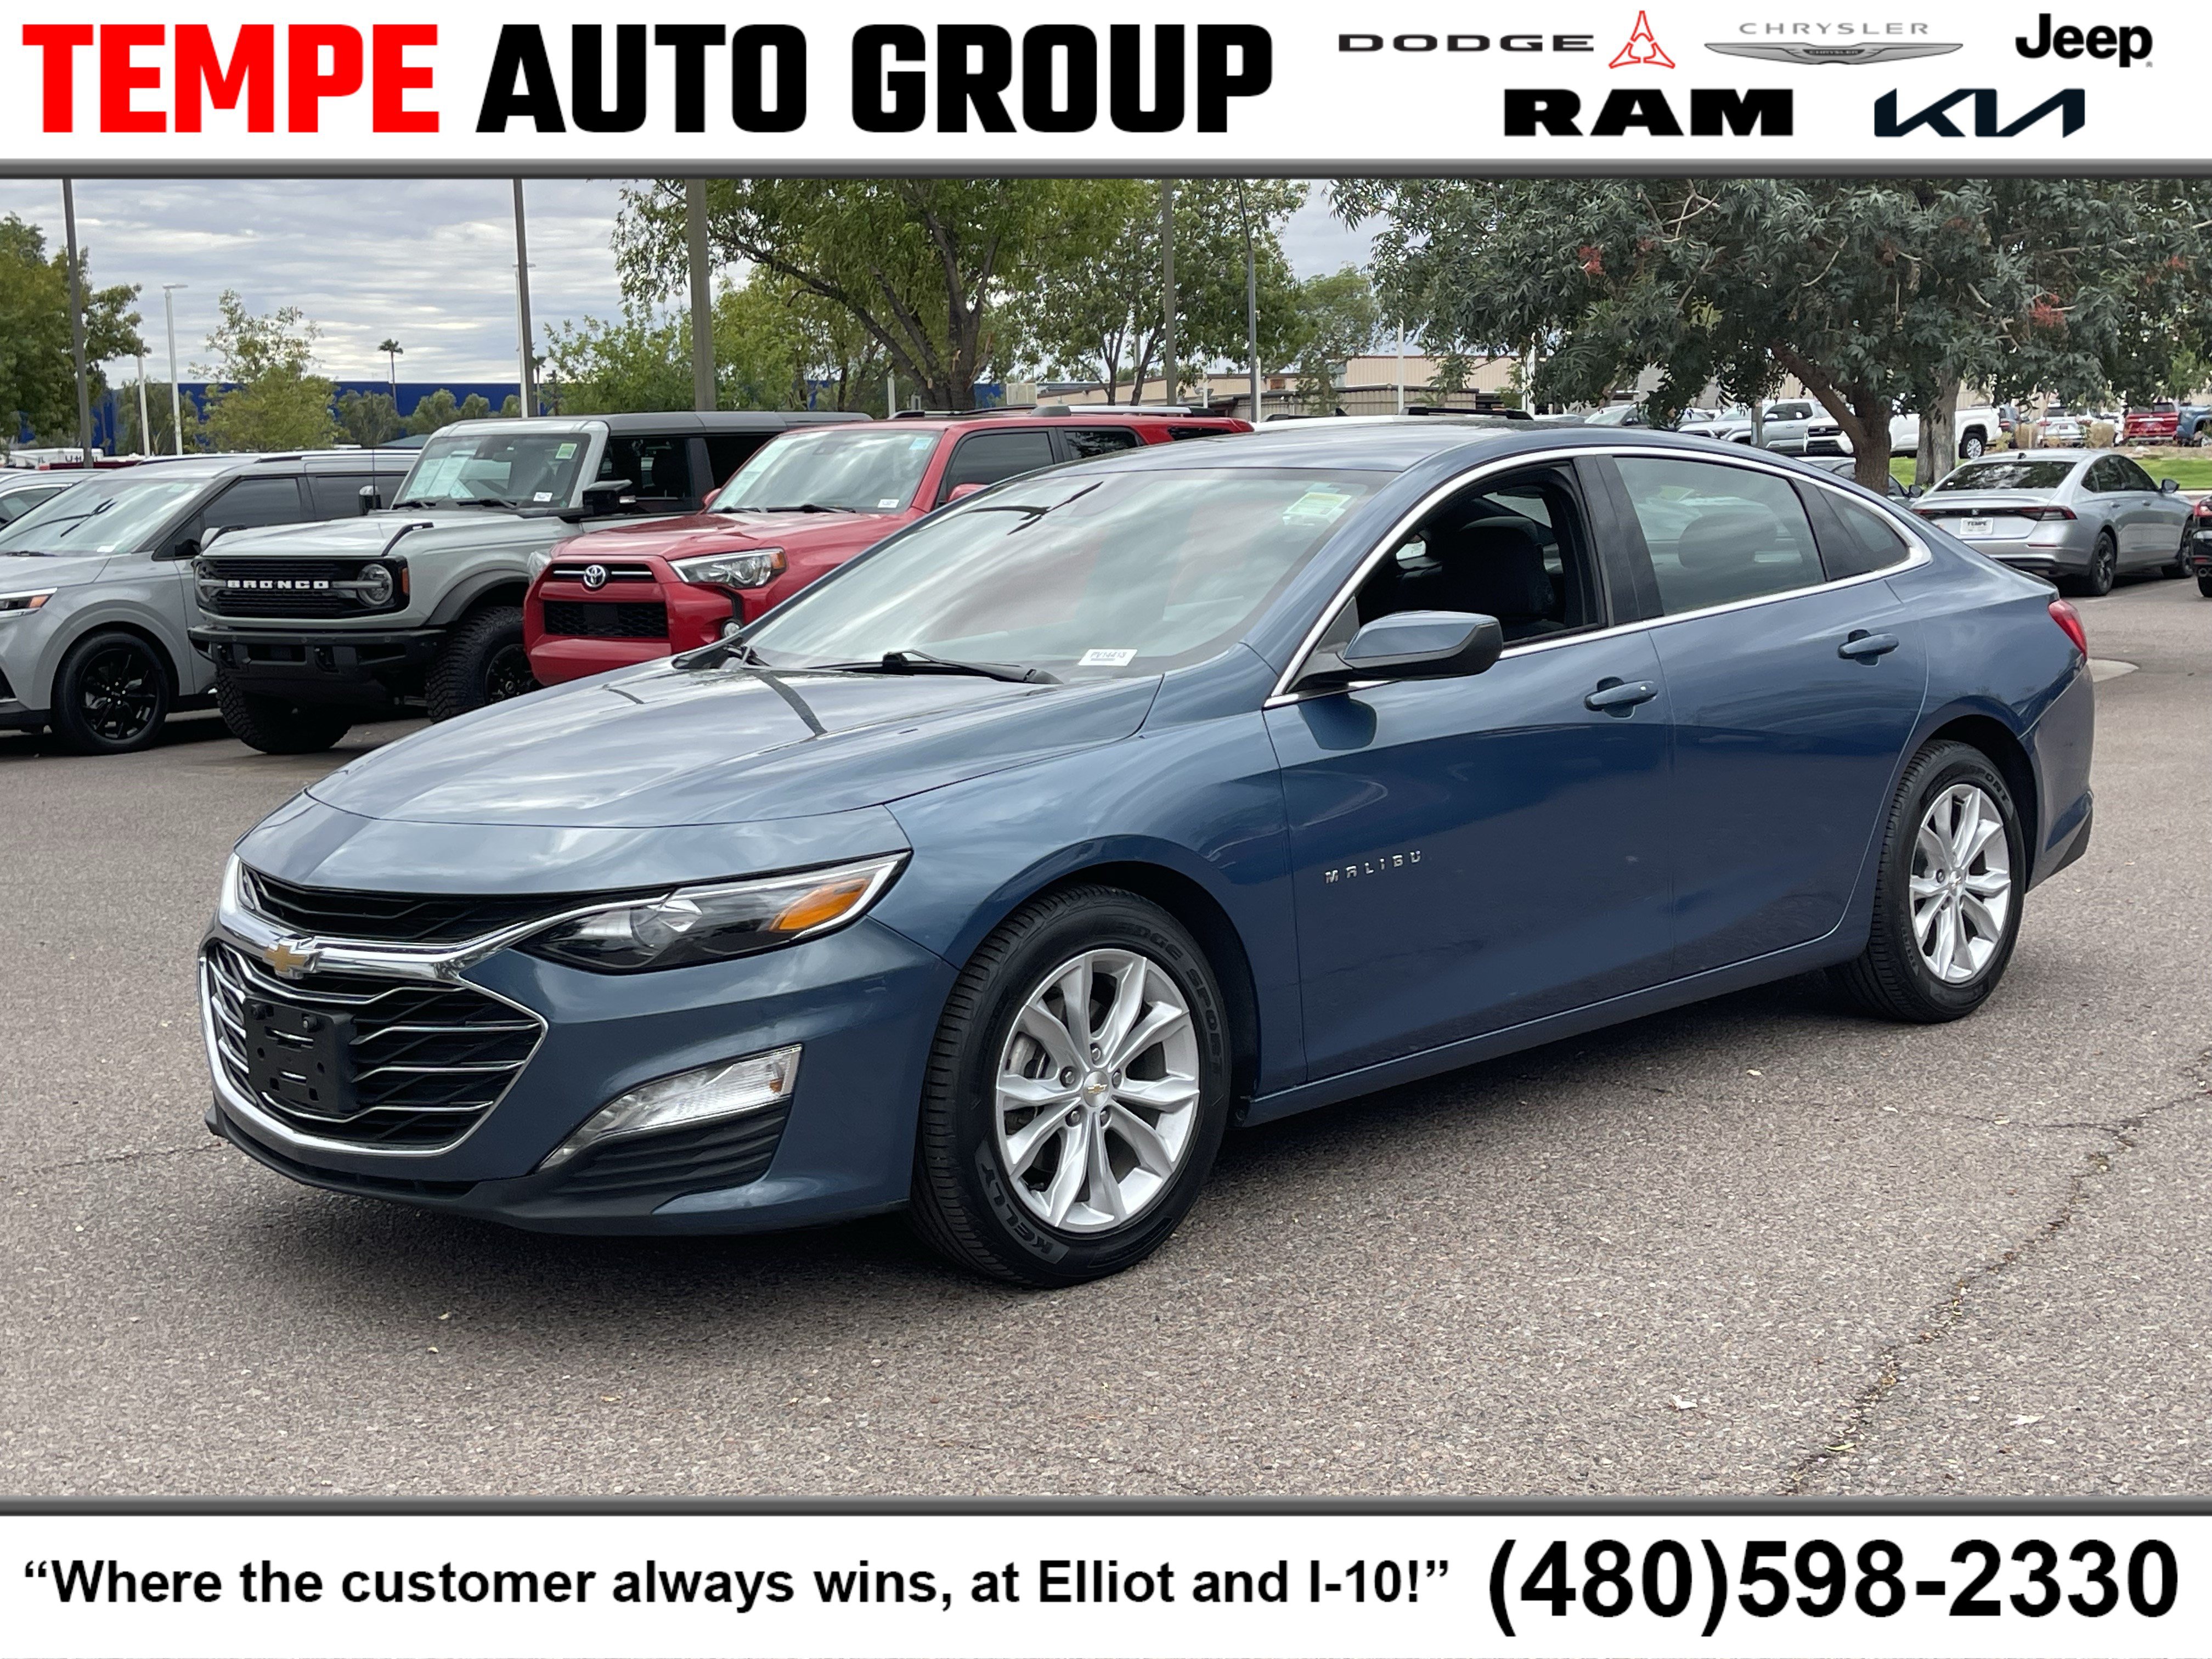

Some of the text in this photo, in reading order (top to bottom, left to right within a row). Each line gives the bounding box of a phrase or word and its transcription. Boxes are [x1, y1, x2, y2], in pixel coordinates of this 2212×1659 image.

[227, 580, 329, 589] BRONCO
[1325, 850, 1421, 884] MALIBU
[980, 1163, 1054, 1255] KELLY
